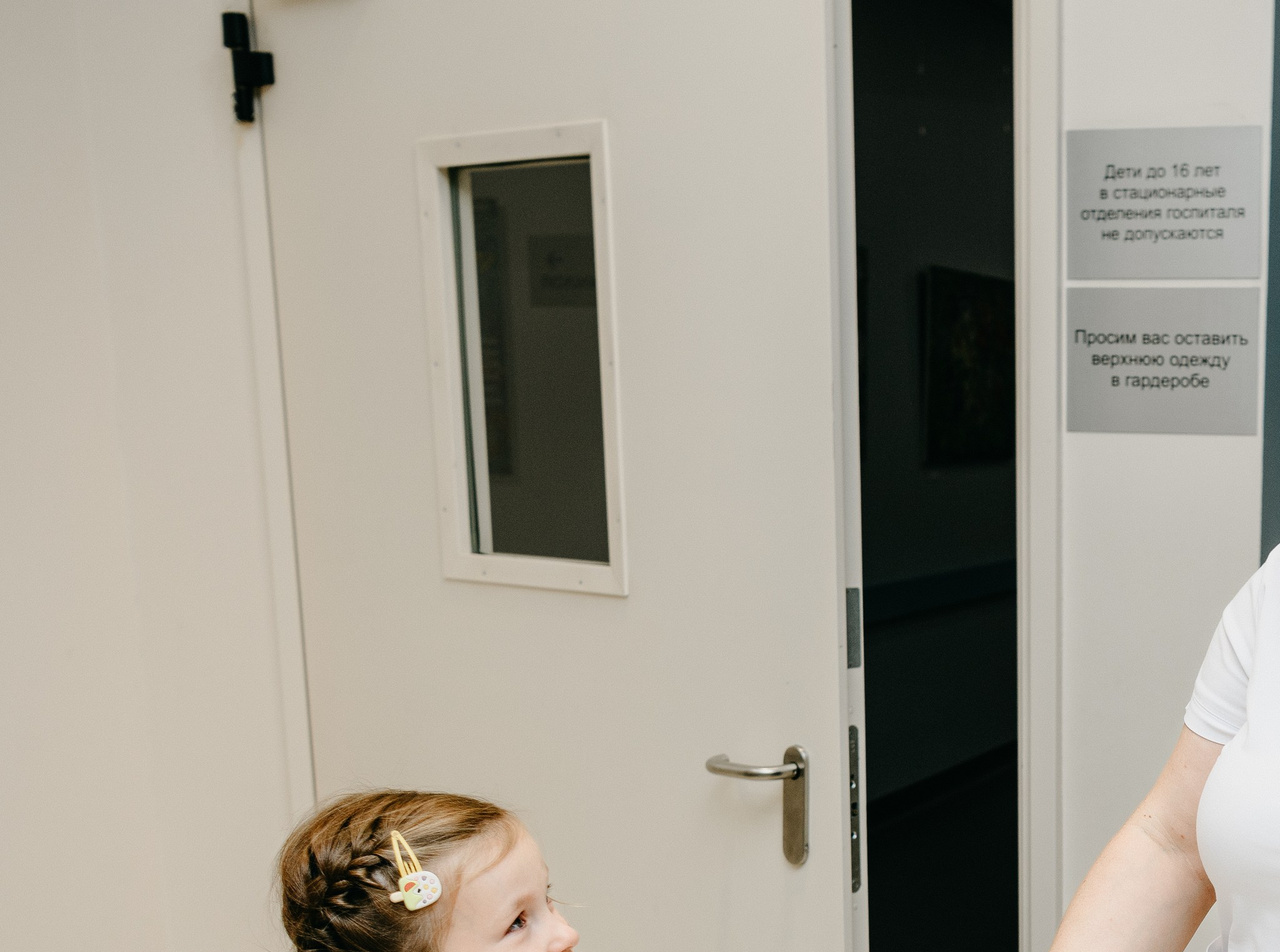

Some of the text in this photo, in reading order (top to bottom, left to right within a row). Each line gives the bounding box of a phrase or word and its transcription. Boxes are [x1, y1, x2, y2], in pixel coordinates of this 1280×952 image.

[1104, 164, 1220, 180] Дети до 16 лет
[1099, 186, 1226, 201] в стационарные
[1080, 206, 1245, 221] отделения госпиталя
[1101, 228, 1224, 243] не допускаются
[1075, 330, 1249, 347] Просим вас оставить
[1092, 353, 1231, 370] верхнюю одежду
[1111, 373, 1209, 390] в гардеробе
